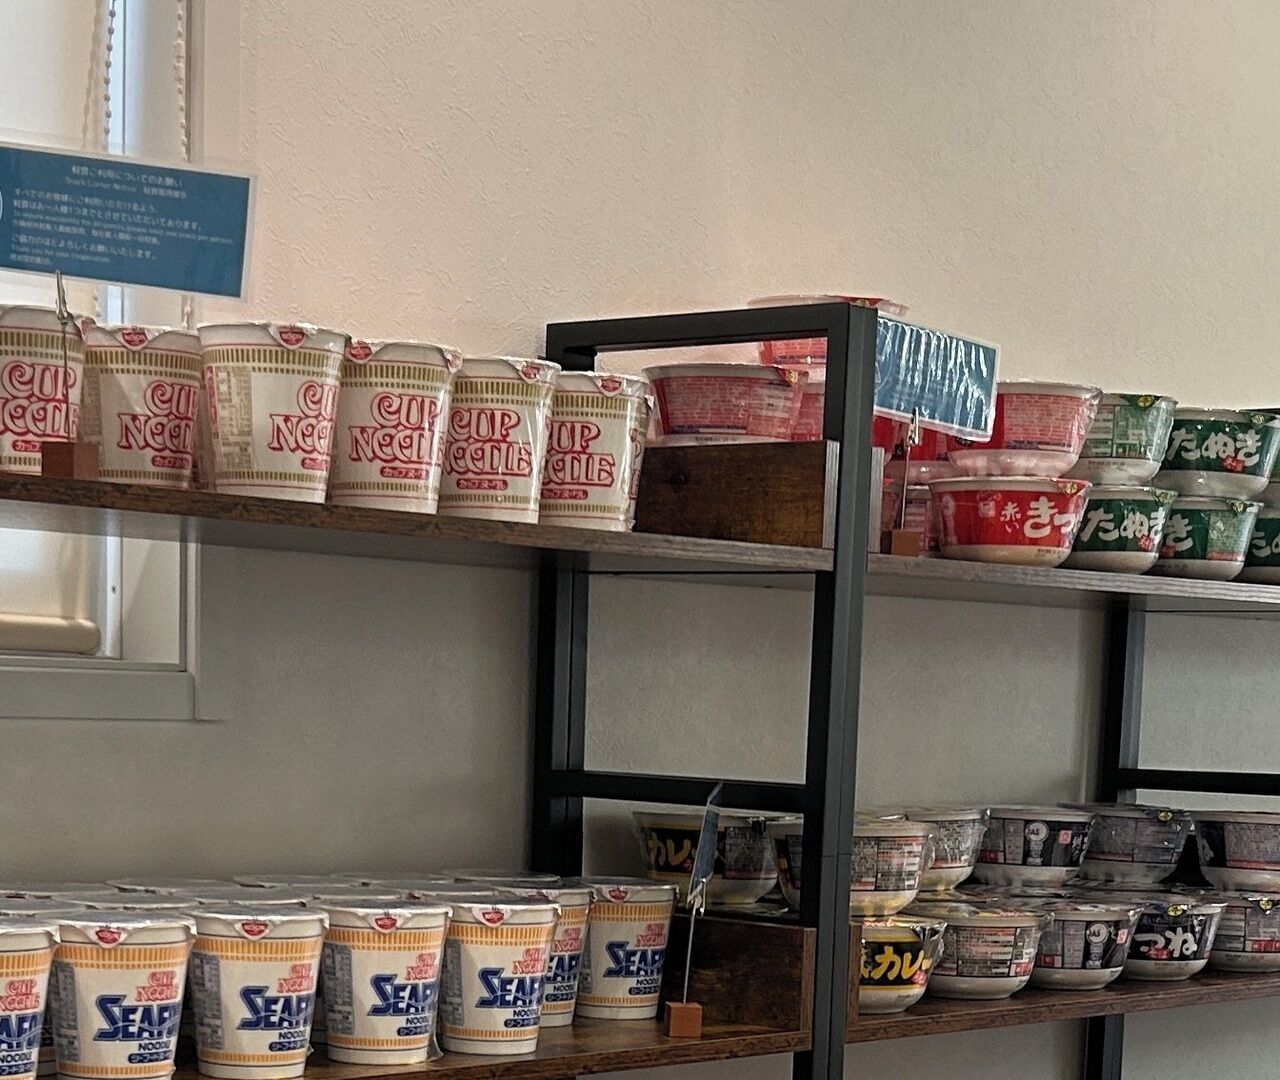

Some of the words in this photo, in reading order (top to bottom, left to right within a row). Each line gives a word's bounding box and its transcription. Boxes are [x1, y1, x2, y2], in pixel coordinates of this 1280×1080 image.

[448, 407, 520, 442] CUP
[1170, 427, 1261, 465] たぬき
[1000, 501, 1020, 533] 赤い
[1080, 507, 1165, 542] たぬき
